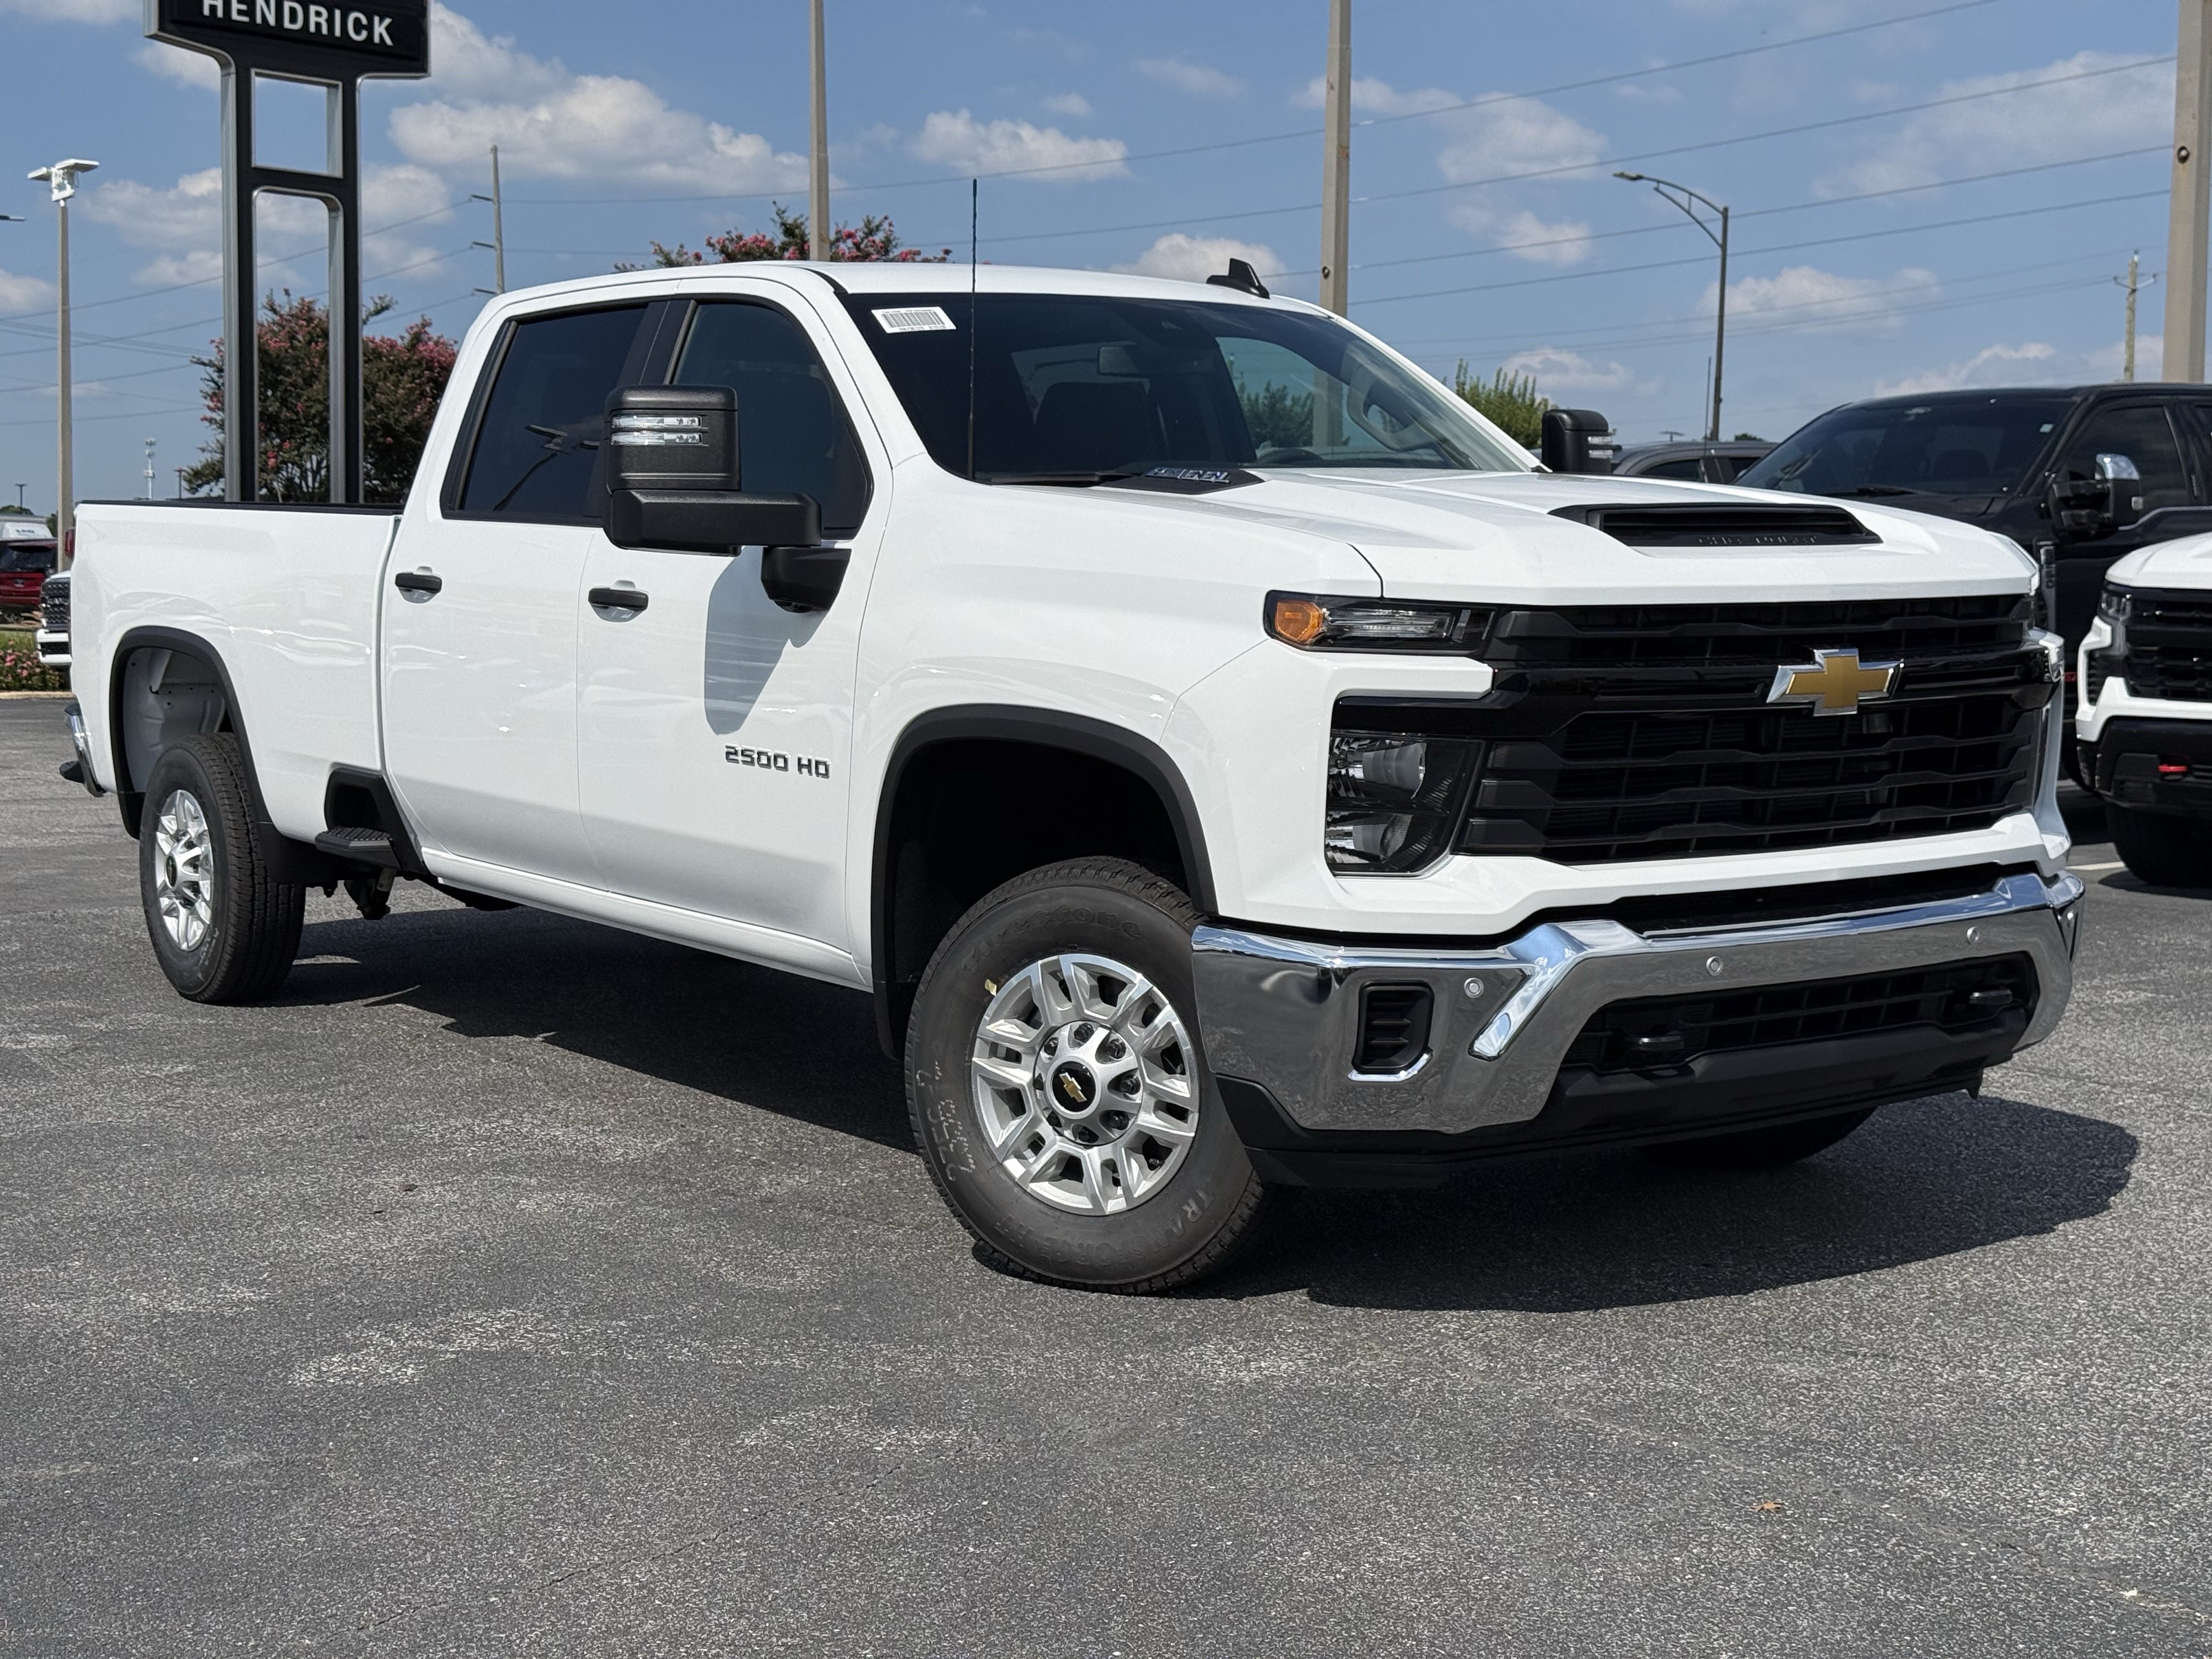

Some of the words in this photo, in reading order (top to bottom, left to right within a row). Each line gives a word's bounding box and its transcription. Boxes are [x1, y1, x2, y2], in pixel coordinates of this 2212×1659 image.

[202, 0, 394, 46] HENDRICK
[725, 742, 791, 772] 2500
[797, 753, 831, 779] HD
[961, 904, 1142, 975] Firestone
[1038, 1187, 1215, 1267] TRANSFORCE
